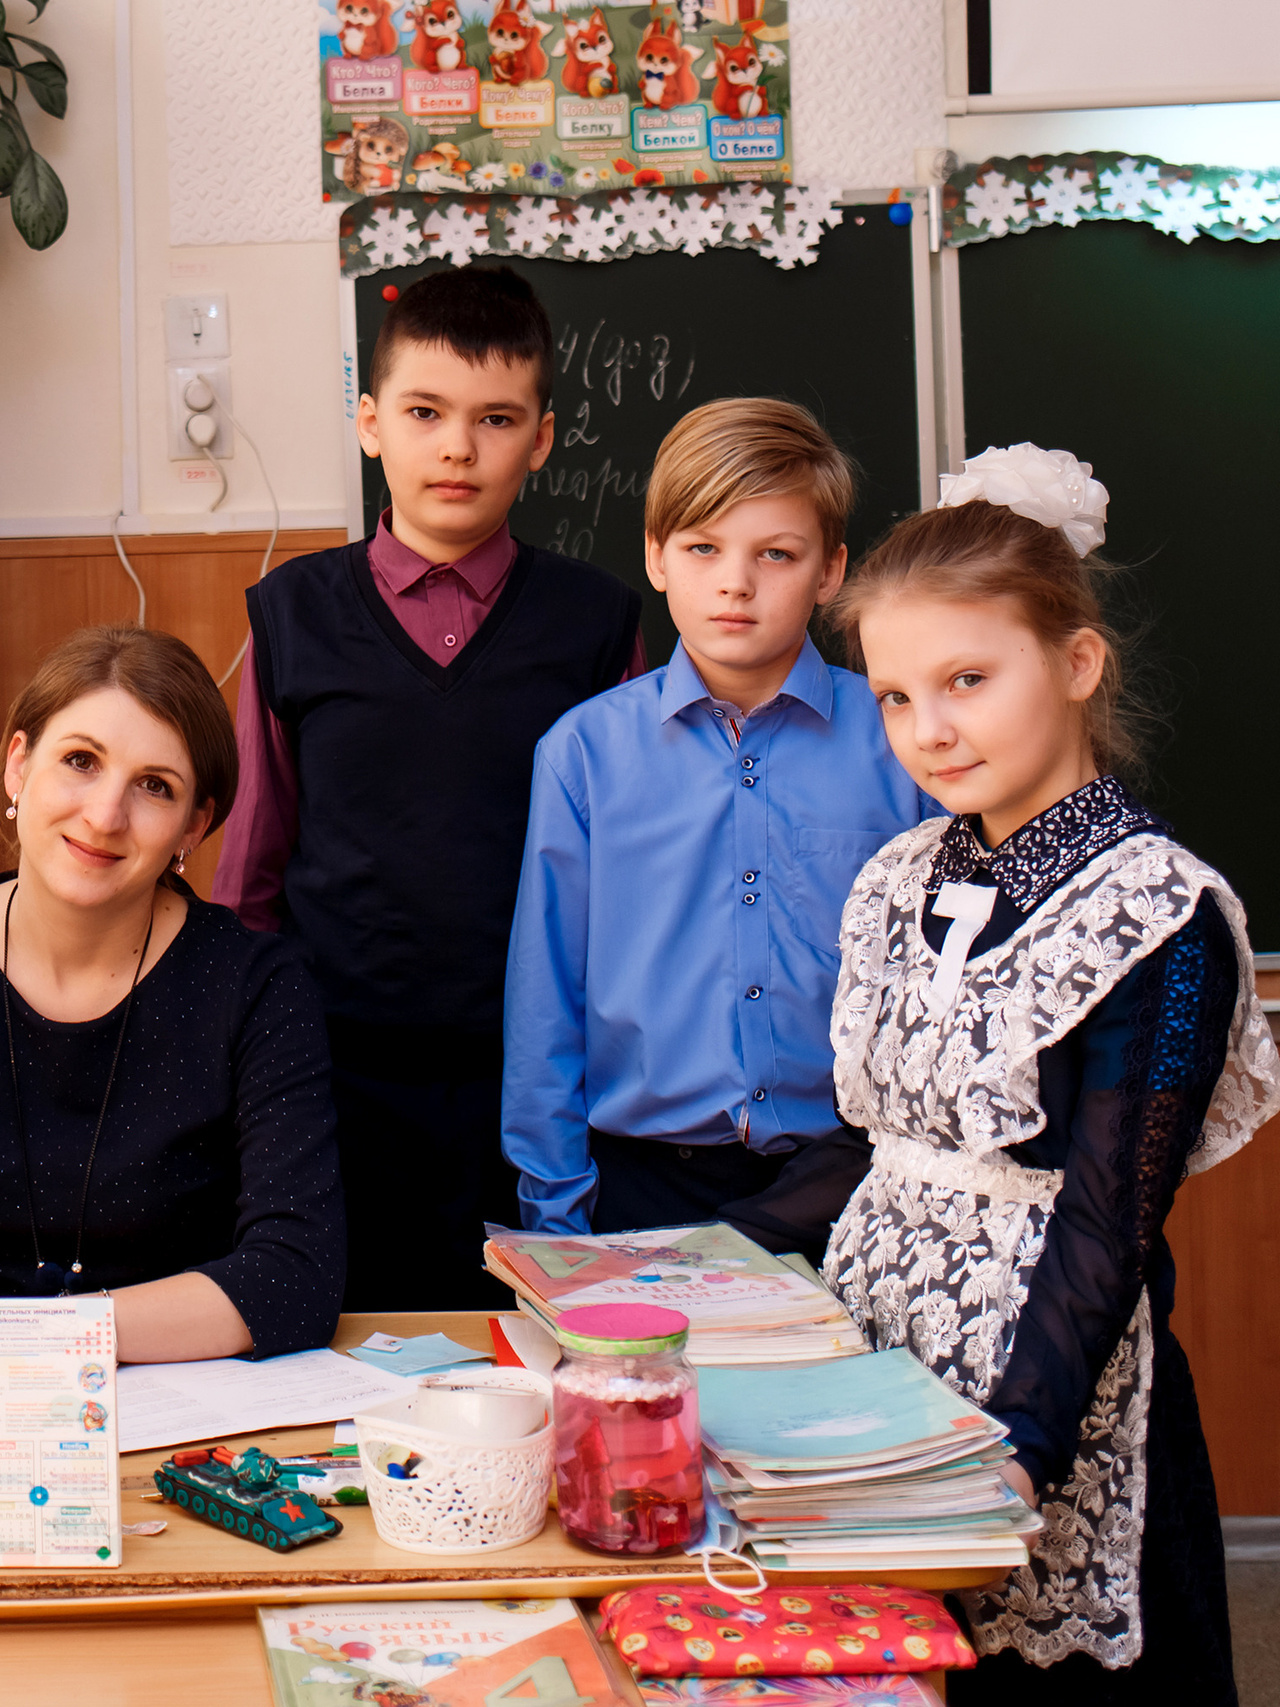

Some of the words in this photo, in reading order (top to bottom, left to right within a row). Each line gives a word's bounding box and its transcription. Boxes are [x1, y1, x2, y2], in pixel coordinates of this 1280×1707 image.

[343, 85, 386, 97] Белка
[420, 97, 463, 109] Белки
[495, 109, 538, 122] Белке
[571, 122, 614, 136] Белку
[644, 132, 696, 146] Белкой
[719, 143, 728, 155] О
[734, 143, 774, 155] белке
[287, 1619, 453, 1636] Русский
[484, 1656, 597, 1707] 4
